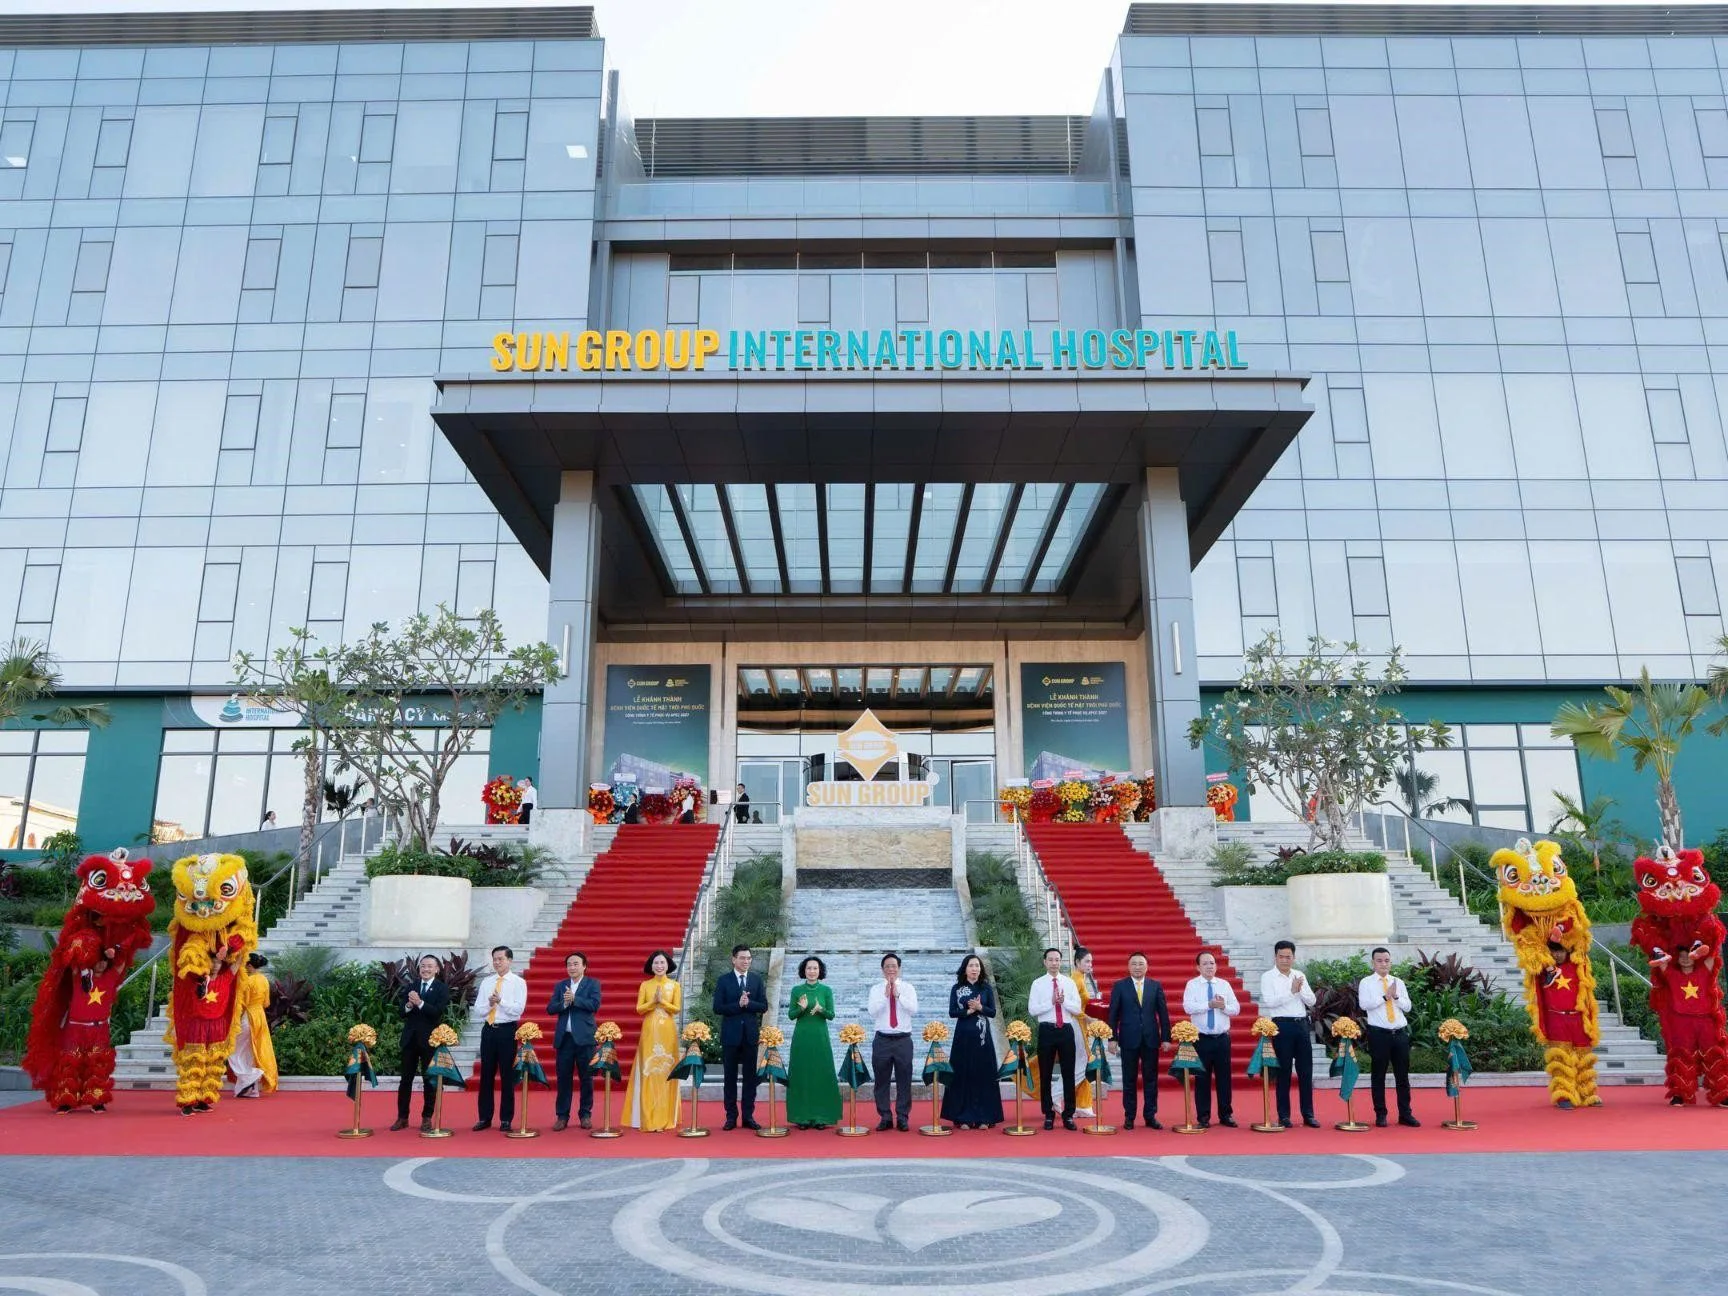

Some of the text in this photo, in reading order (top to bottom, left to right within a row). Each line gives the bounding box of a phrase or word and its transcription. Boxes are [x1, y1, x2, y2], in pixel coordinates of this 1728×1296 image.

[491, 329, 1249, 371] SUN GROUP INTERNATIONAL HOSPITAL
[808, 783, 929, 805] SUN GROUP
